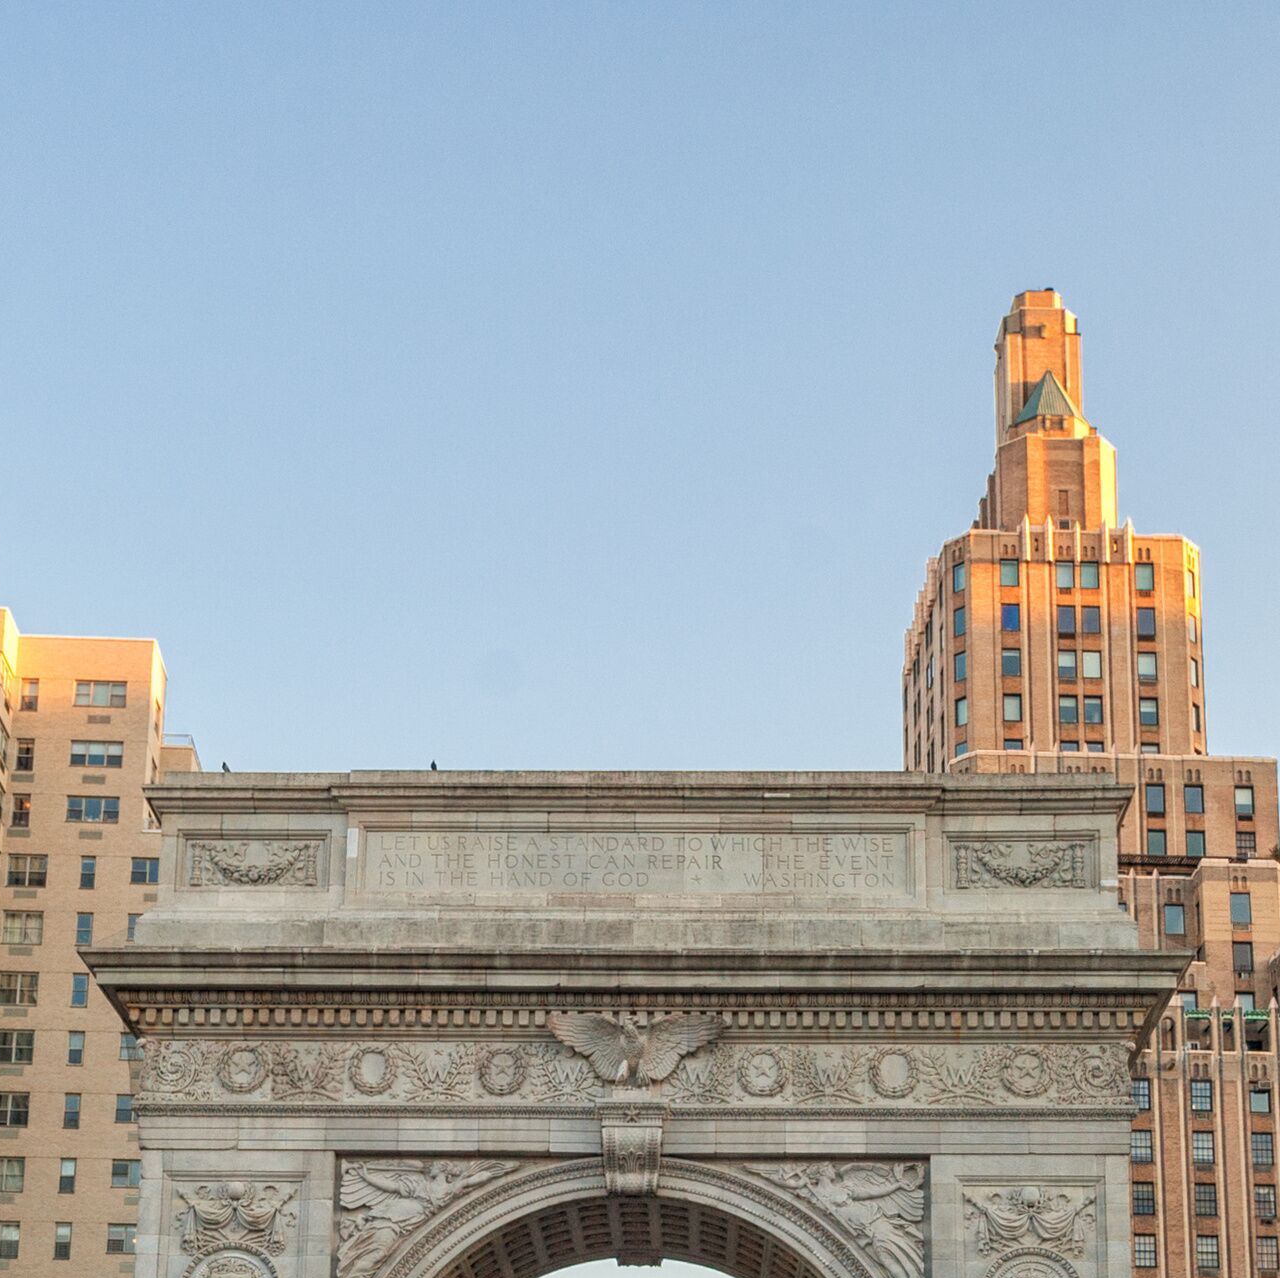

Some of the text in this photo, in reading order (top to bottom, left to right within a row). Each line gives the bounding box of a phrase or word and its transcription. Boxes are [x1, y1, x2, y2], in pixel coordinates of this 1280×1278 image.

[380, 835, 894, 853] LET US RAISE A STANDARD TO WHICH THE WISE
[378, 853, 894, 871] AND THE HONEST CAN REPAIR THE EVENT
[379, 871, 895, 888] IS IN THE HAND OF GOD WASHINGTON
[295, 1059, 321, 1082] W
[426, 1060, 452, 1083] W
[553, 1061, 583, 1084] W
[682, 1062, 713, 1085] W
[815, 1063, 844, 1087] W
[946, 1065, 977, 1087] W
